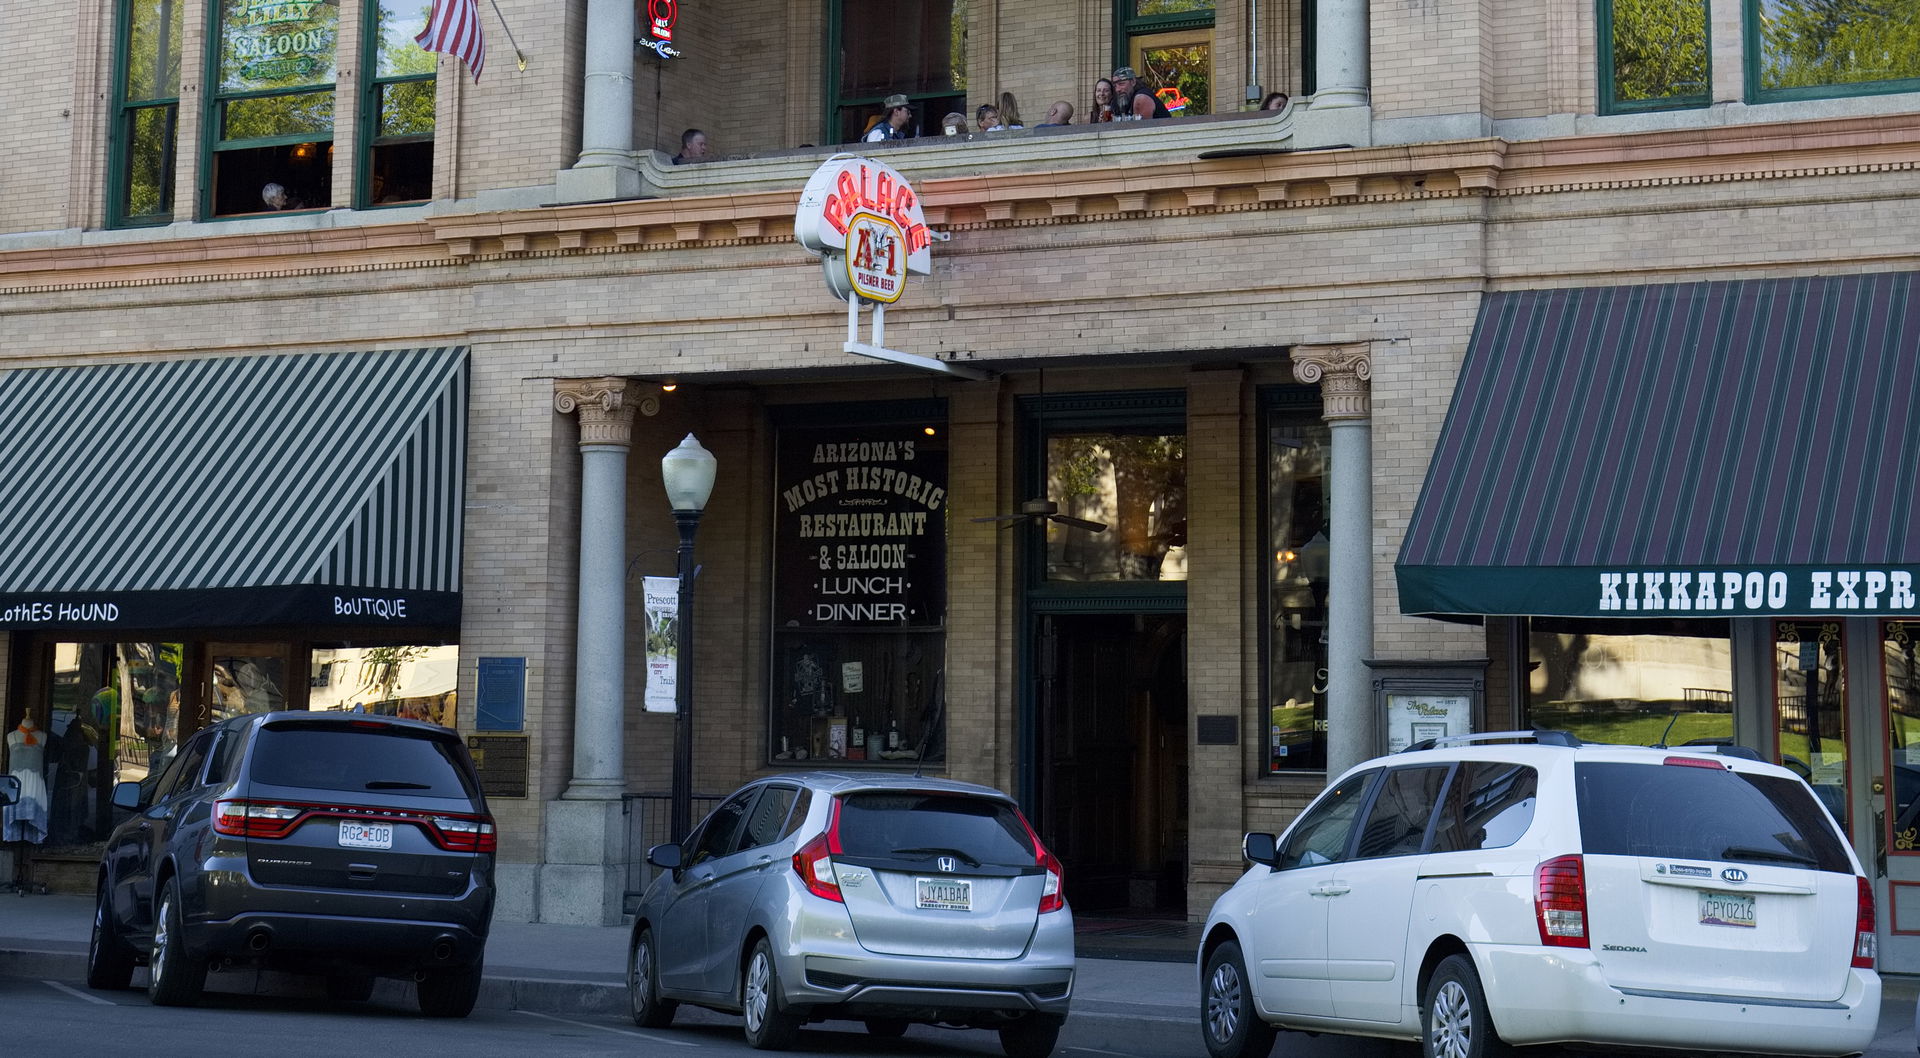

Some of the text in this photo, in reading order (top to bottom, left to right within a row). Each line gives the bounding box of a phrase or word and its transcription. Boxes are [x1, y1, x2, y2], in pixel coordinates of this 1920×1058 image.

[248, 3, 314, 26] LILLY
[235, 27, 324, 60] SALOON
[823, 164, 932, 256] PALACE
[857, 272, 895, 292] PILSNER BEER
[813, 440, 915, 463] ARIZONA'S
[783, 466, 945, 513] MOST HISTORIC
[800, 512, 927, 538] RESTAURANT
[819, 543, 906, 570] & SALOON
[822, 576, 903, 595] LUNCH
[1599, 570, 1916, 611] KIKKAPOO EXPR
[647, 593, 676, 605] Prescott
[0, 603, 53, 622] othES
[816, 603, 906, 621] DINNER
[1724, 869, 1745, 881] KIA
[1706, 900, 1754, 921] CPY0216
